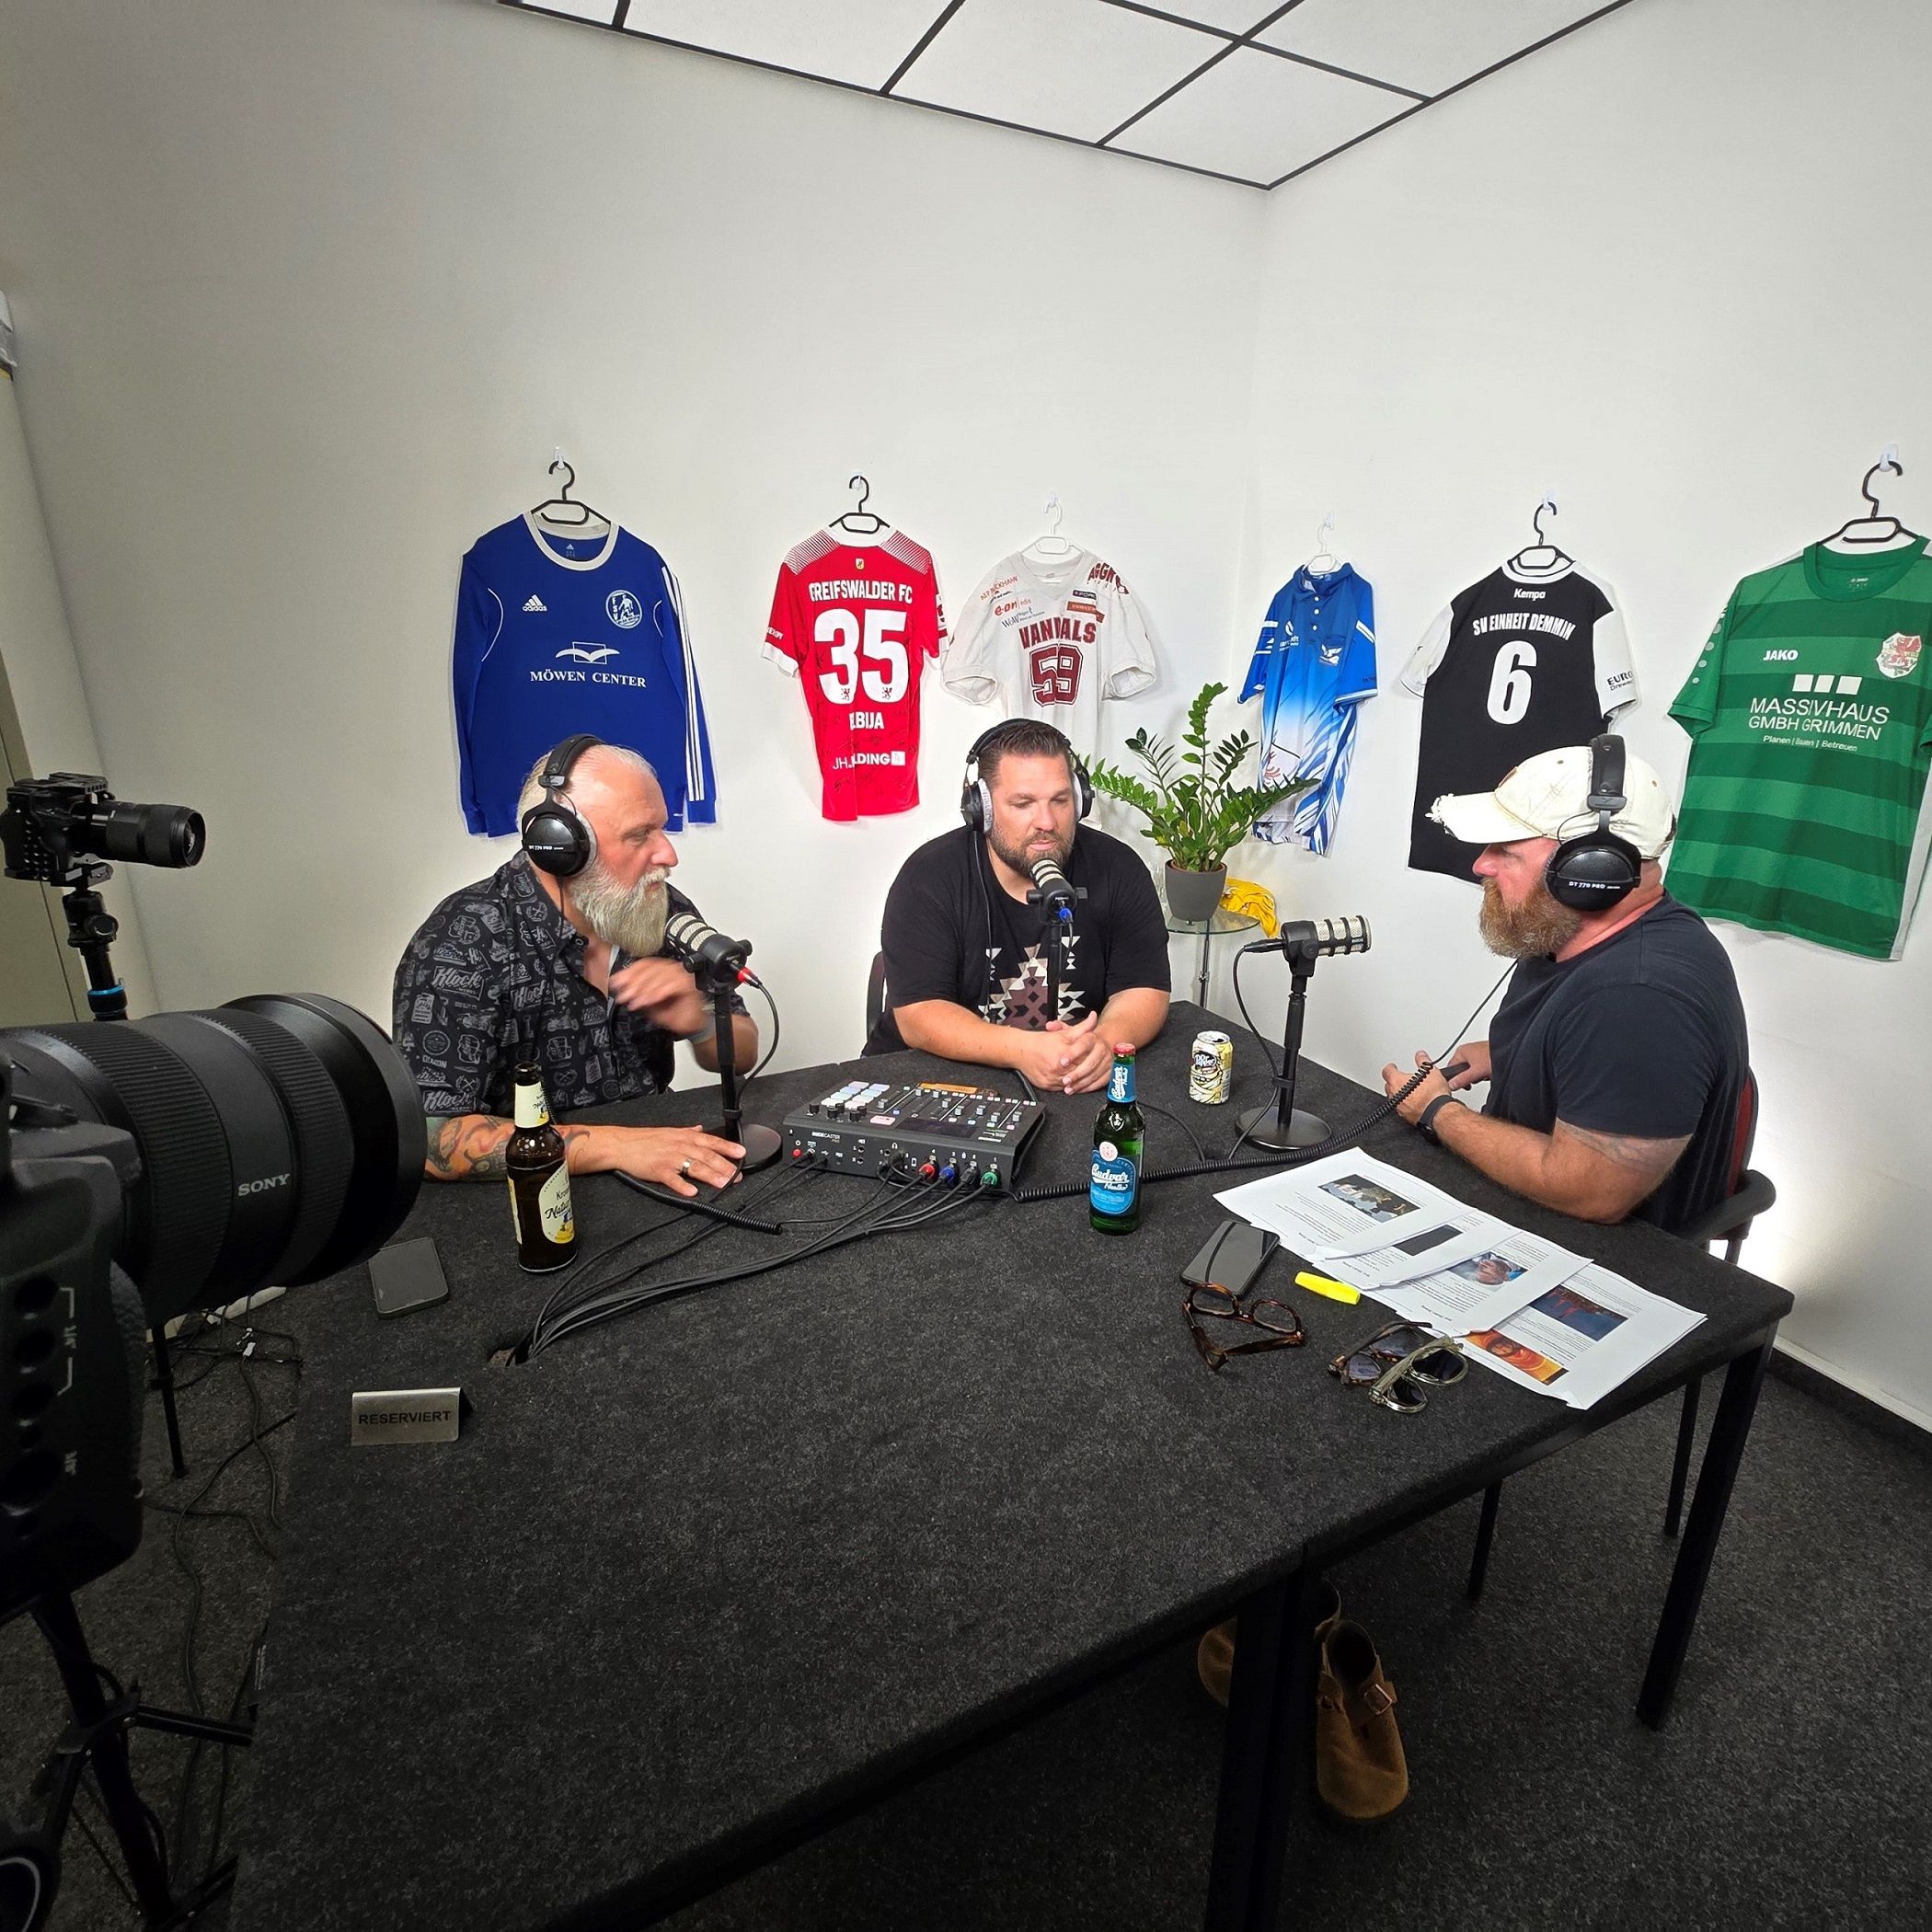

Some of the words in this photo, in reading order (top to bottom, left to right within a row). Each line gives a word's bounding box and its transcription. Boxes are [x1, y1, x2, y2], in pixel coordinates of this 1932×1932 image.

[899, 584, 913, 604] FC
[1513, 588, 1546, 601] Kempa
[1472, 616, 1488, 636] SV
[1489, 613, 1530, 631] EINHEIT
[1528, 613, 1576, 640] DEMMIN
[814, 608, 909, 704] 35
[1763, 650, 1799, 661] JAKO
[530, 669, 586, 682] MÖWEN
[592, 673, 646, 687] CENTER
[1029, 643, 1083, 707] 59
[1487, 640, 1537, 725] 6
[1750, 697, 1890, 724] MASSIVHAUS
[1748, 716, 1800, 730] GMBH
[1802, 719, 1881, 741] GRIMMEN
[1763, 735, 1791, 744] Planen
[1822, 740, 1857, 752] Betreuen
[238, 1173, 291, 1197] SONY
[358, 1410, 452, 1425] RESERVIERT
